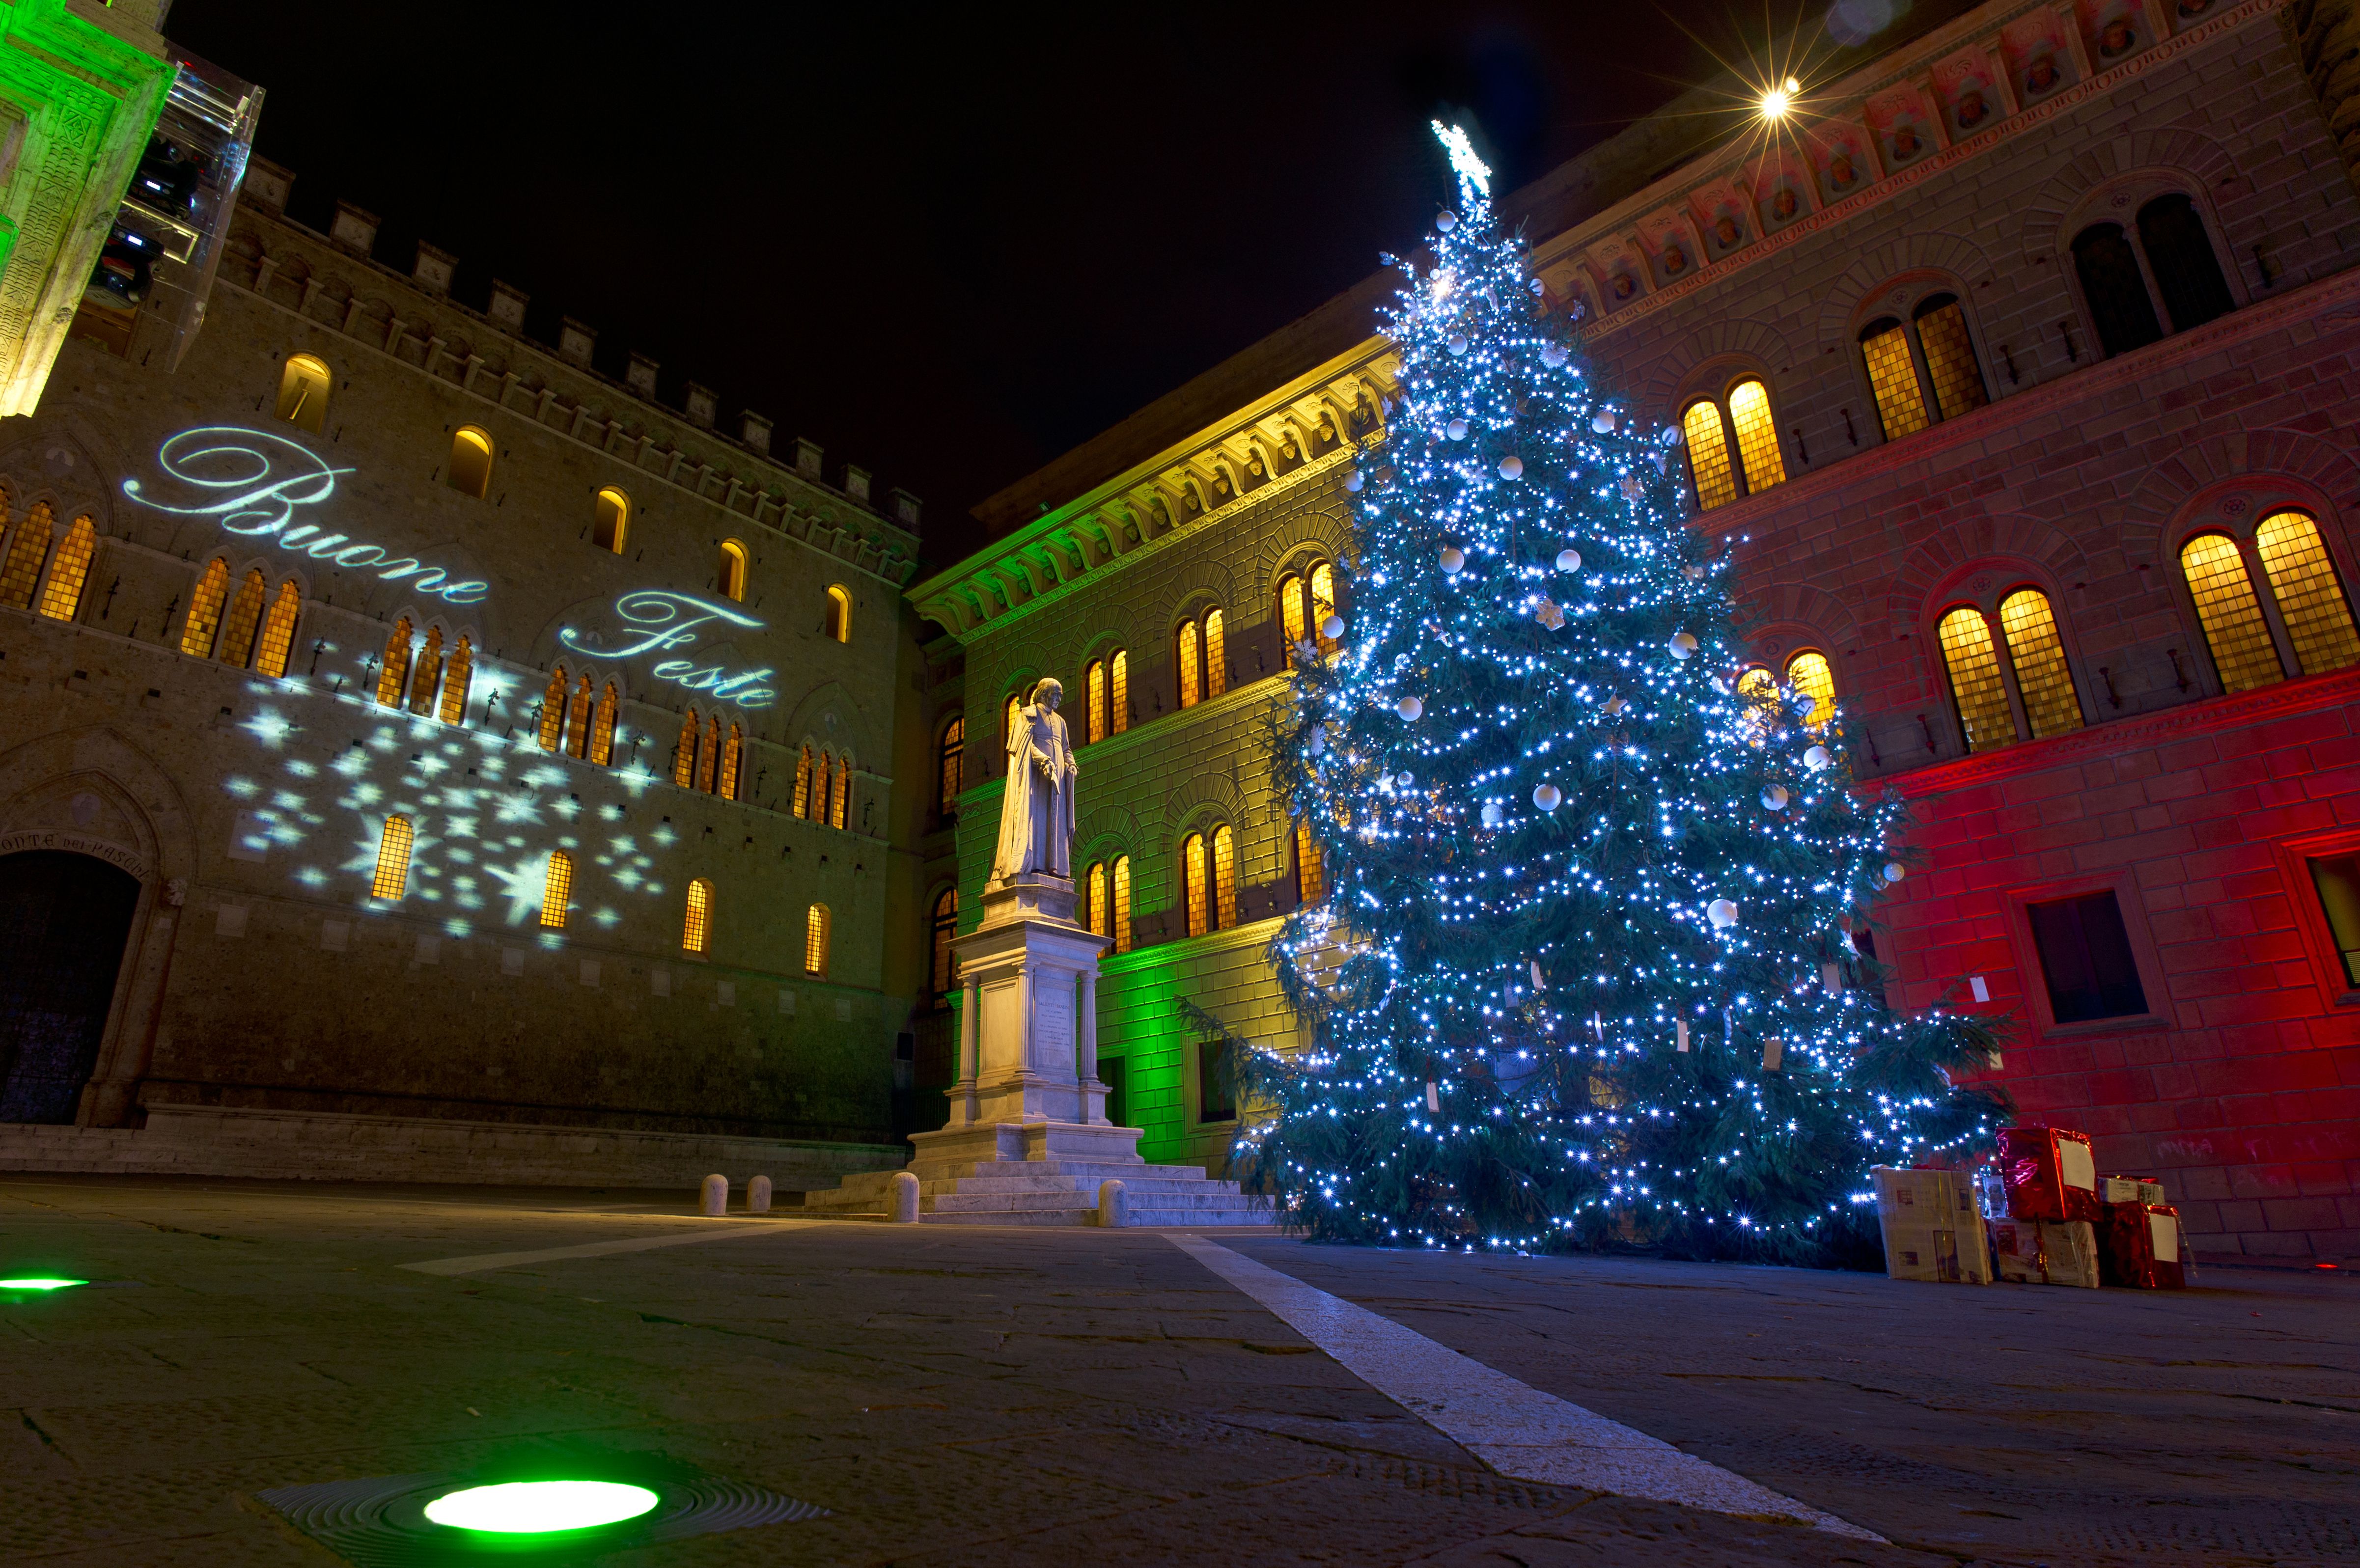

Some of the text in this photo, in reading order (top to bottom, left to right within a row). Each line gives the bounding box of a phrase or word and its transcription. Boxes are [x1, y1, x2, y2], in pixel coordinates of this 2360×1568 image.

[123, 426, 775, 708] Buone Feste
[1, 834, 150, 878] ONTE DEI PASCHI
